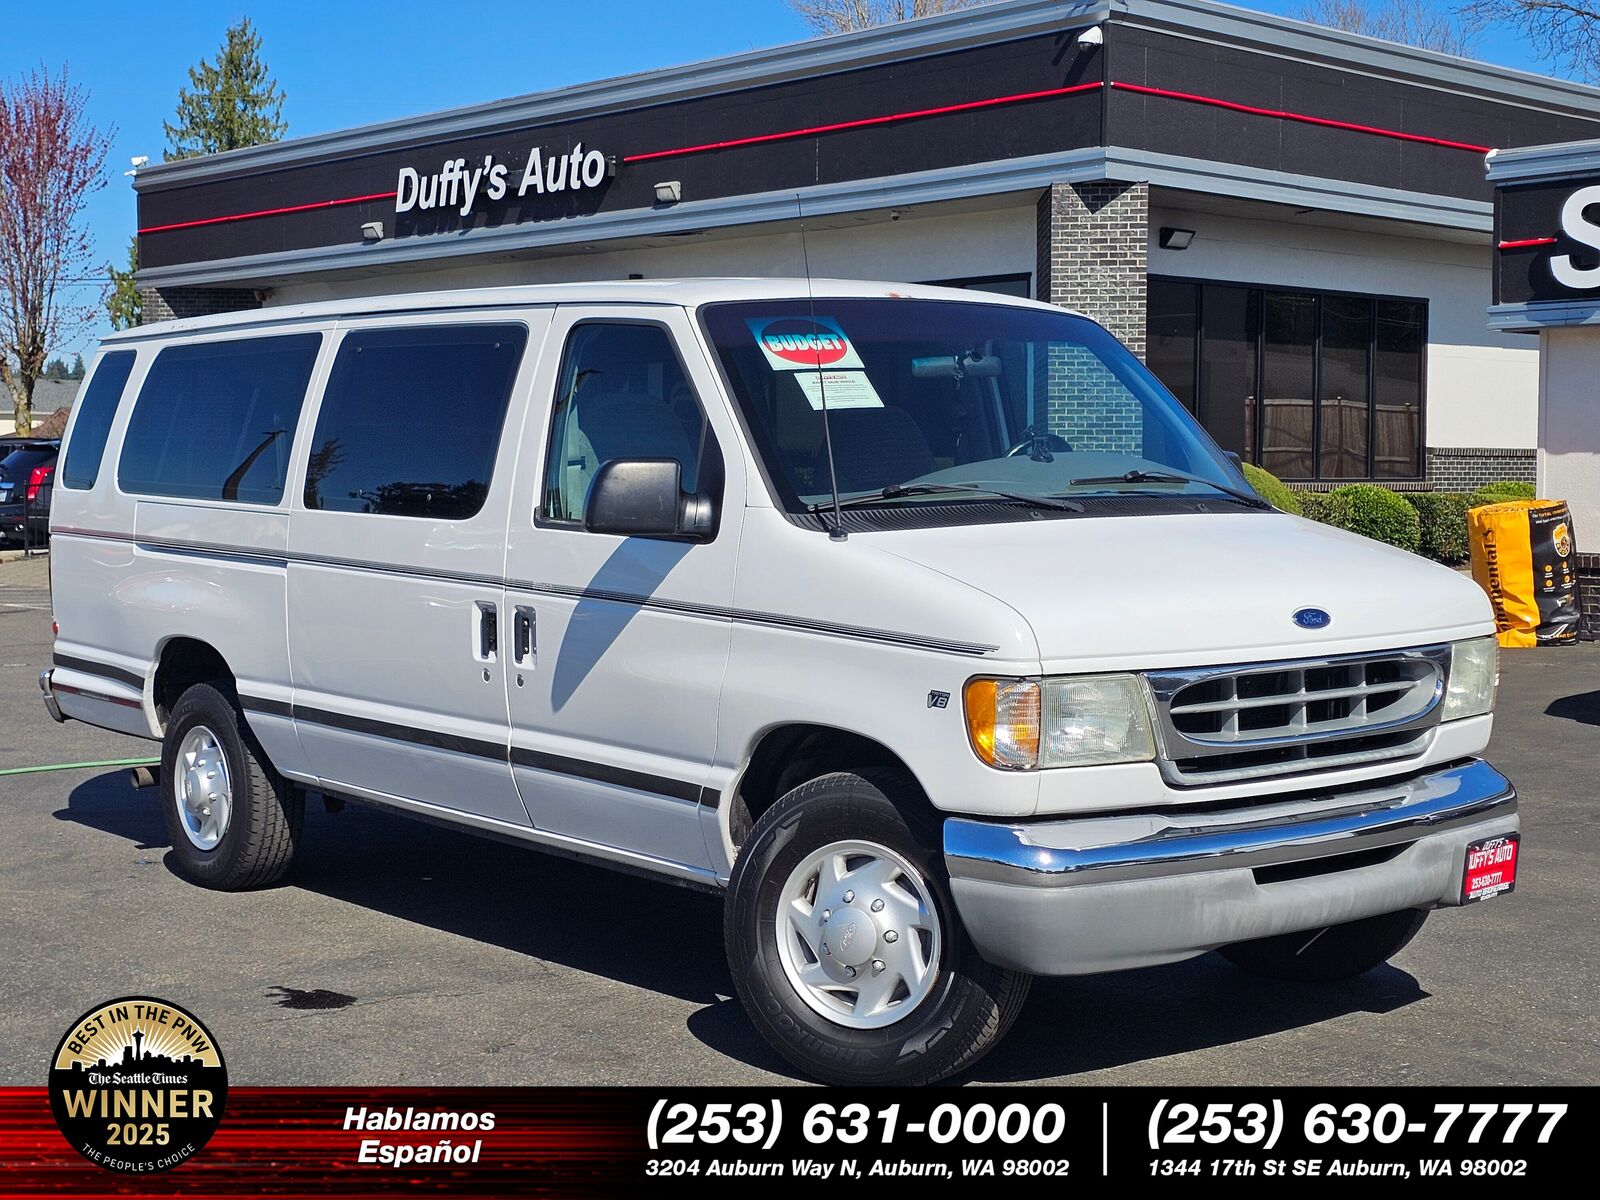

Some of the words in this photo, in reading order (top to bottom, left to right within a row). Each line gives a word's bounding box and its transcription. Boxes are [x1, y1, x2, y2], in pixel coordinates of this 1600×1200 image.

[395, 155, 508, 217] Duffy's
[518, 142, 605, 197] Auto
[766, 334, 842, 351] BUDGET
[1303, 612, 1322, 625] Ford
[928, 694, 948, 708] V8
[1494, 845, 1513, 864] AUTO
